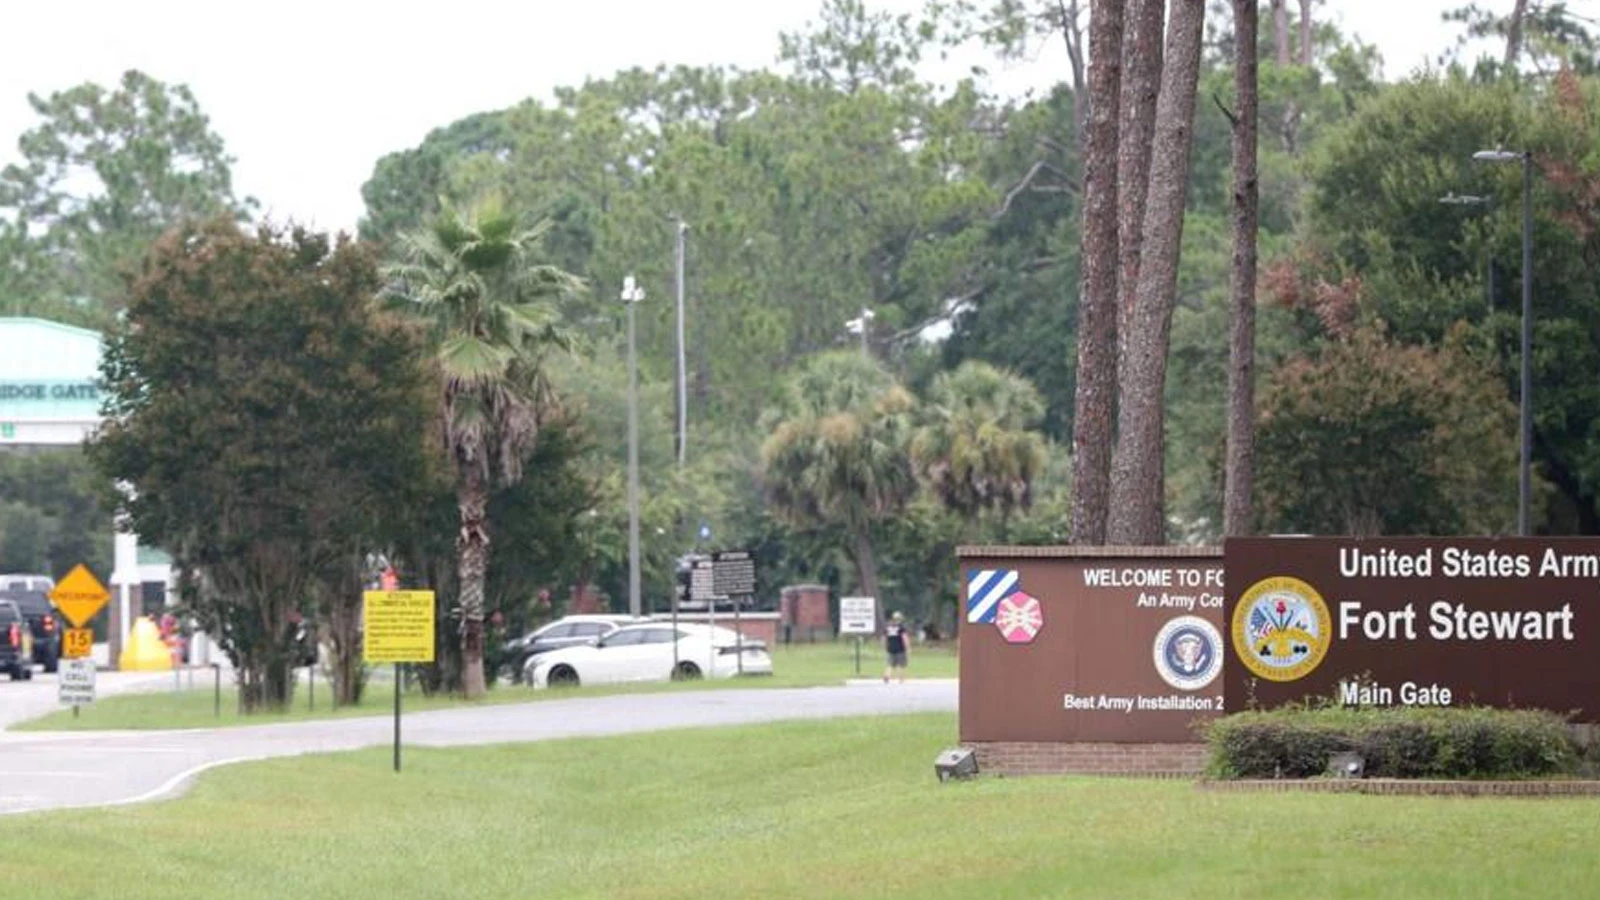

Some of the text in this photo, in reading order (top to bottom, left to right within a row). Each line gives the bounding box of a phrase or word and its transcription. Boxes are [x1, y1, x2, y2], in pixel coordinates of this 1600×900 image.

[0, 384, 98, 400] IDGE GATE
[1340, 547, 1432, 577] United
[1442, 547, 1531, 577] States
[1084, 568, 1172, 587] WELCOME
[1176, 568, 1200, 587] TO
[1137, 593, 1157, 607] An
[1159, 593, 1197, 611] Army
[1340, 601, 1574, 640] Fort Stewart
[70, 632, 88, 646] 15
[1339, 681, 1452, 705] Main Gate
[1063, 694, 1095, 710] Best
[1097, 694, 1134, 713] Army
[1137, 694, 1212, 710] Installation
